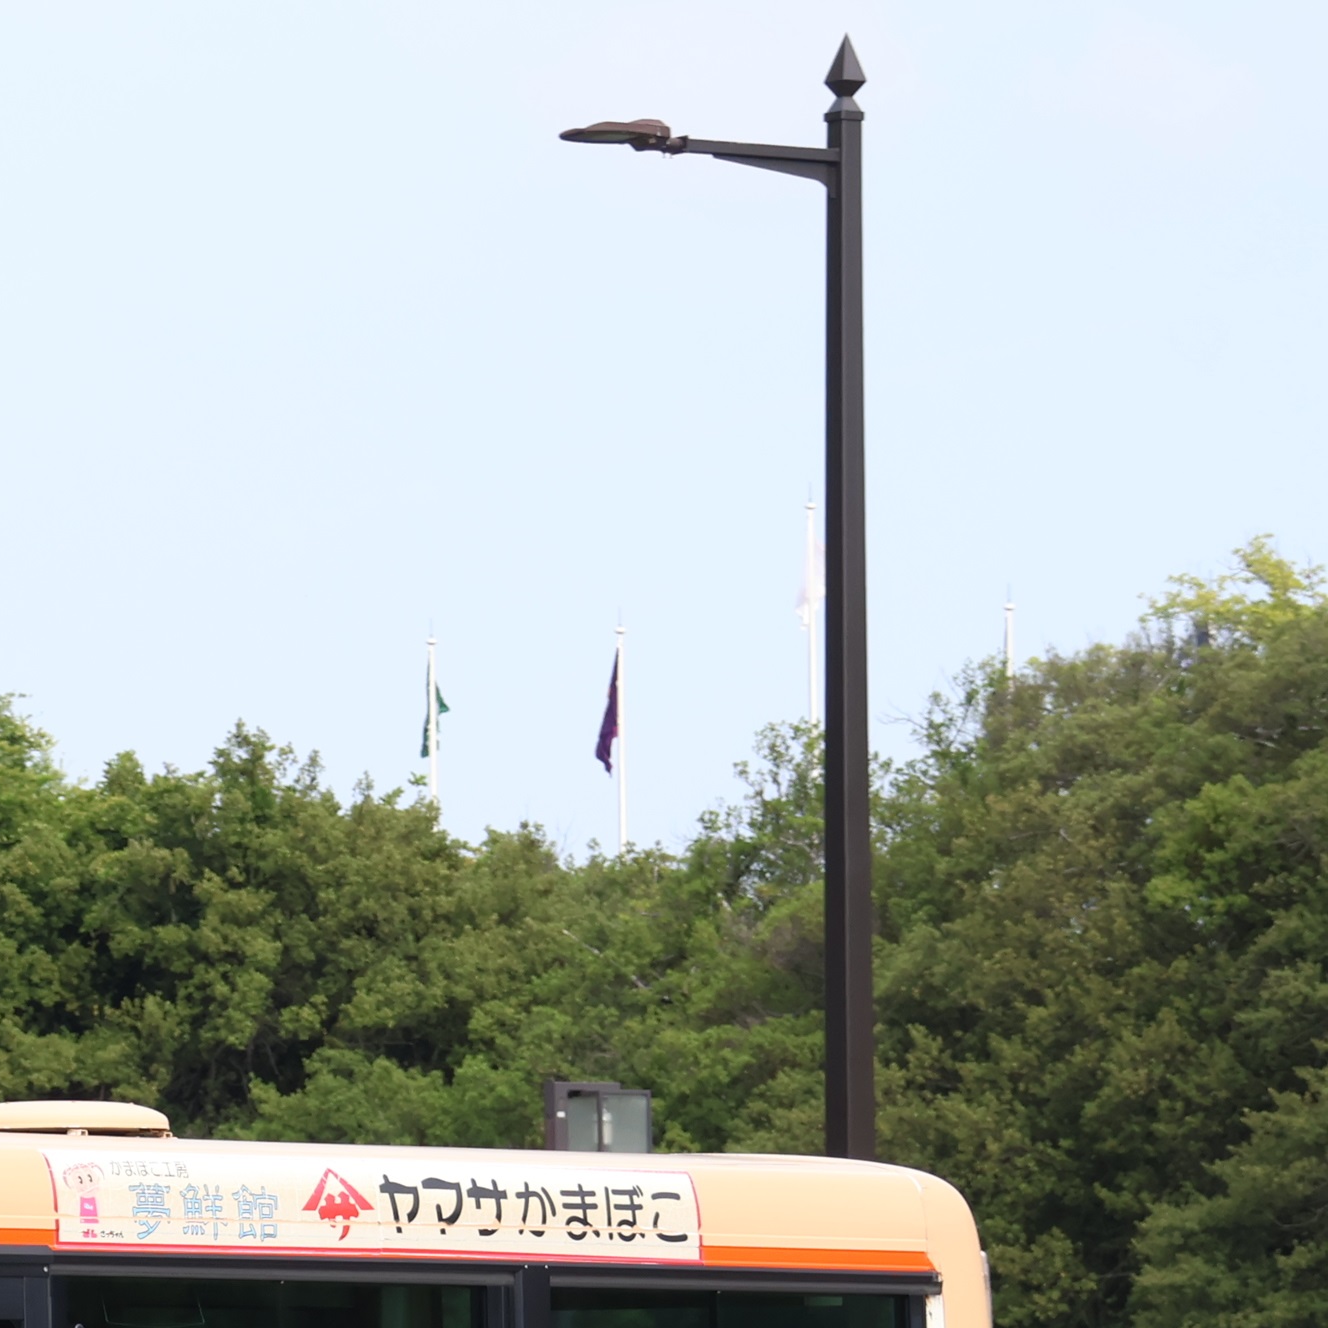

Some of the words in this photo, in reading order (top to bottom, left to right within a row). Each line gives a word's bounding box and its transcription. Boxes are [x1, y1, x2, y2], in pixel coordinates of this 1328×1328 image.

[128, 1182, 279, 1242] 夢鮮館
[379, 1174, 689, 1243] ヤマサかまぼこ
